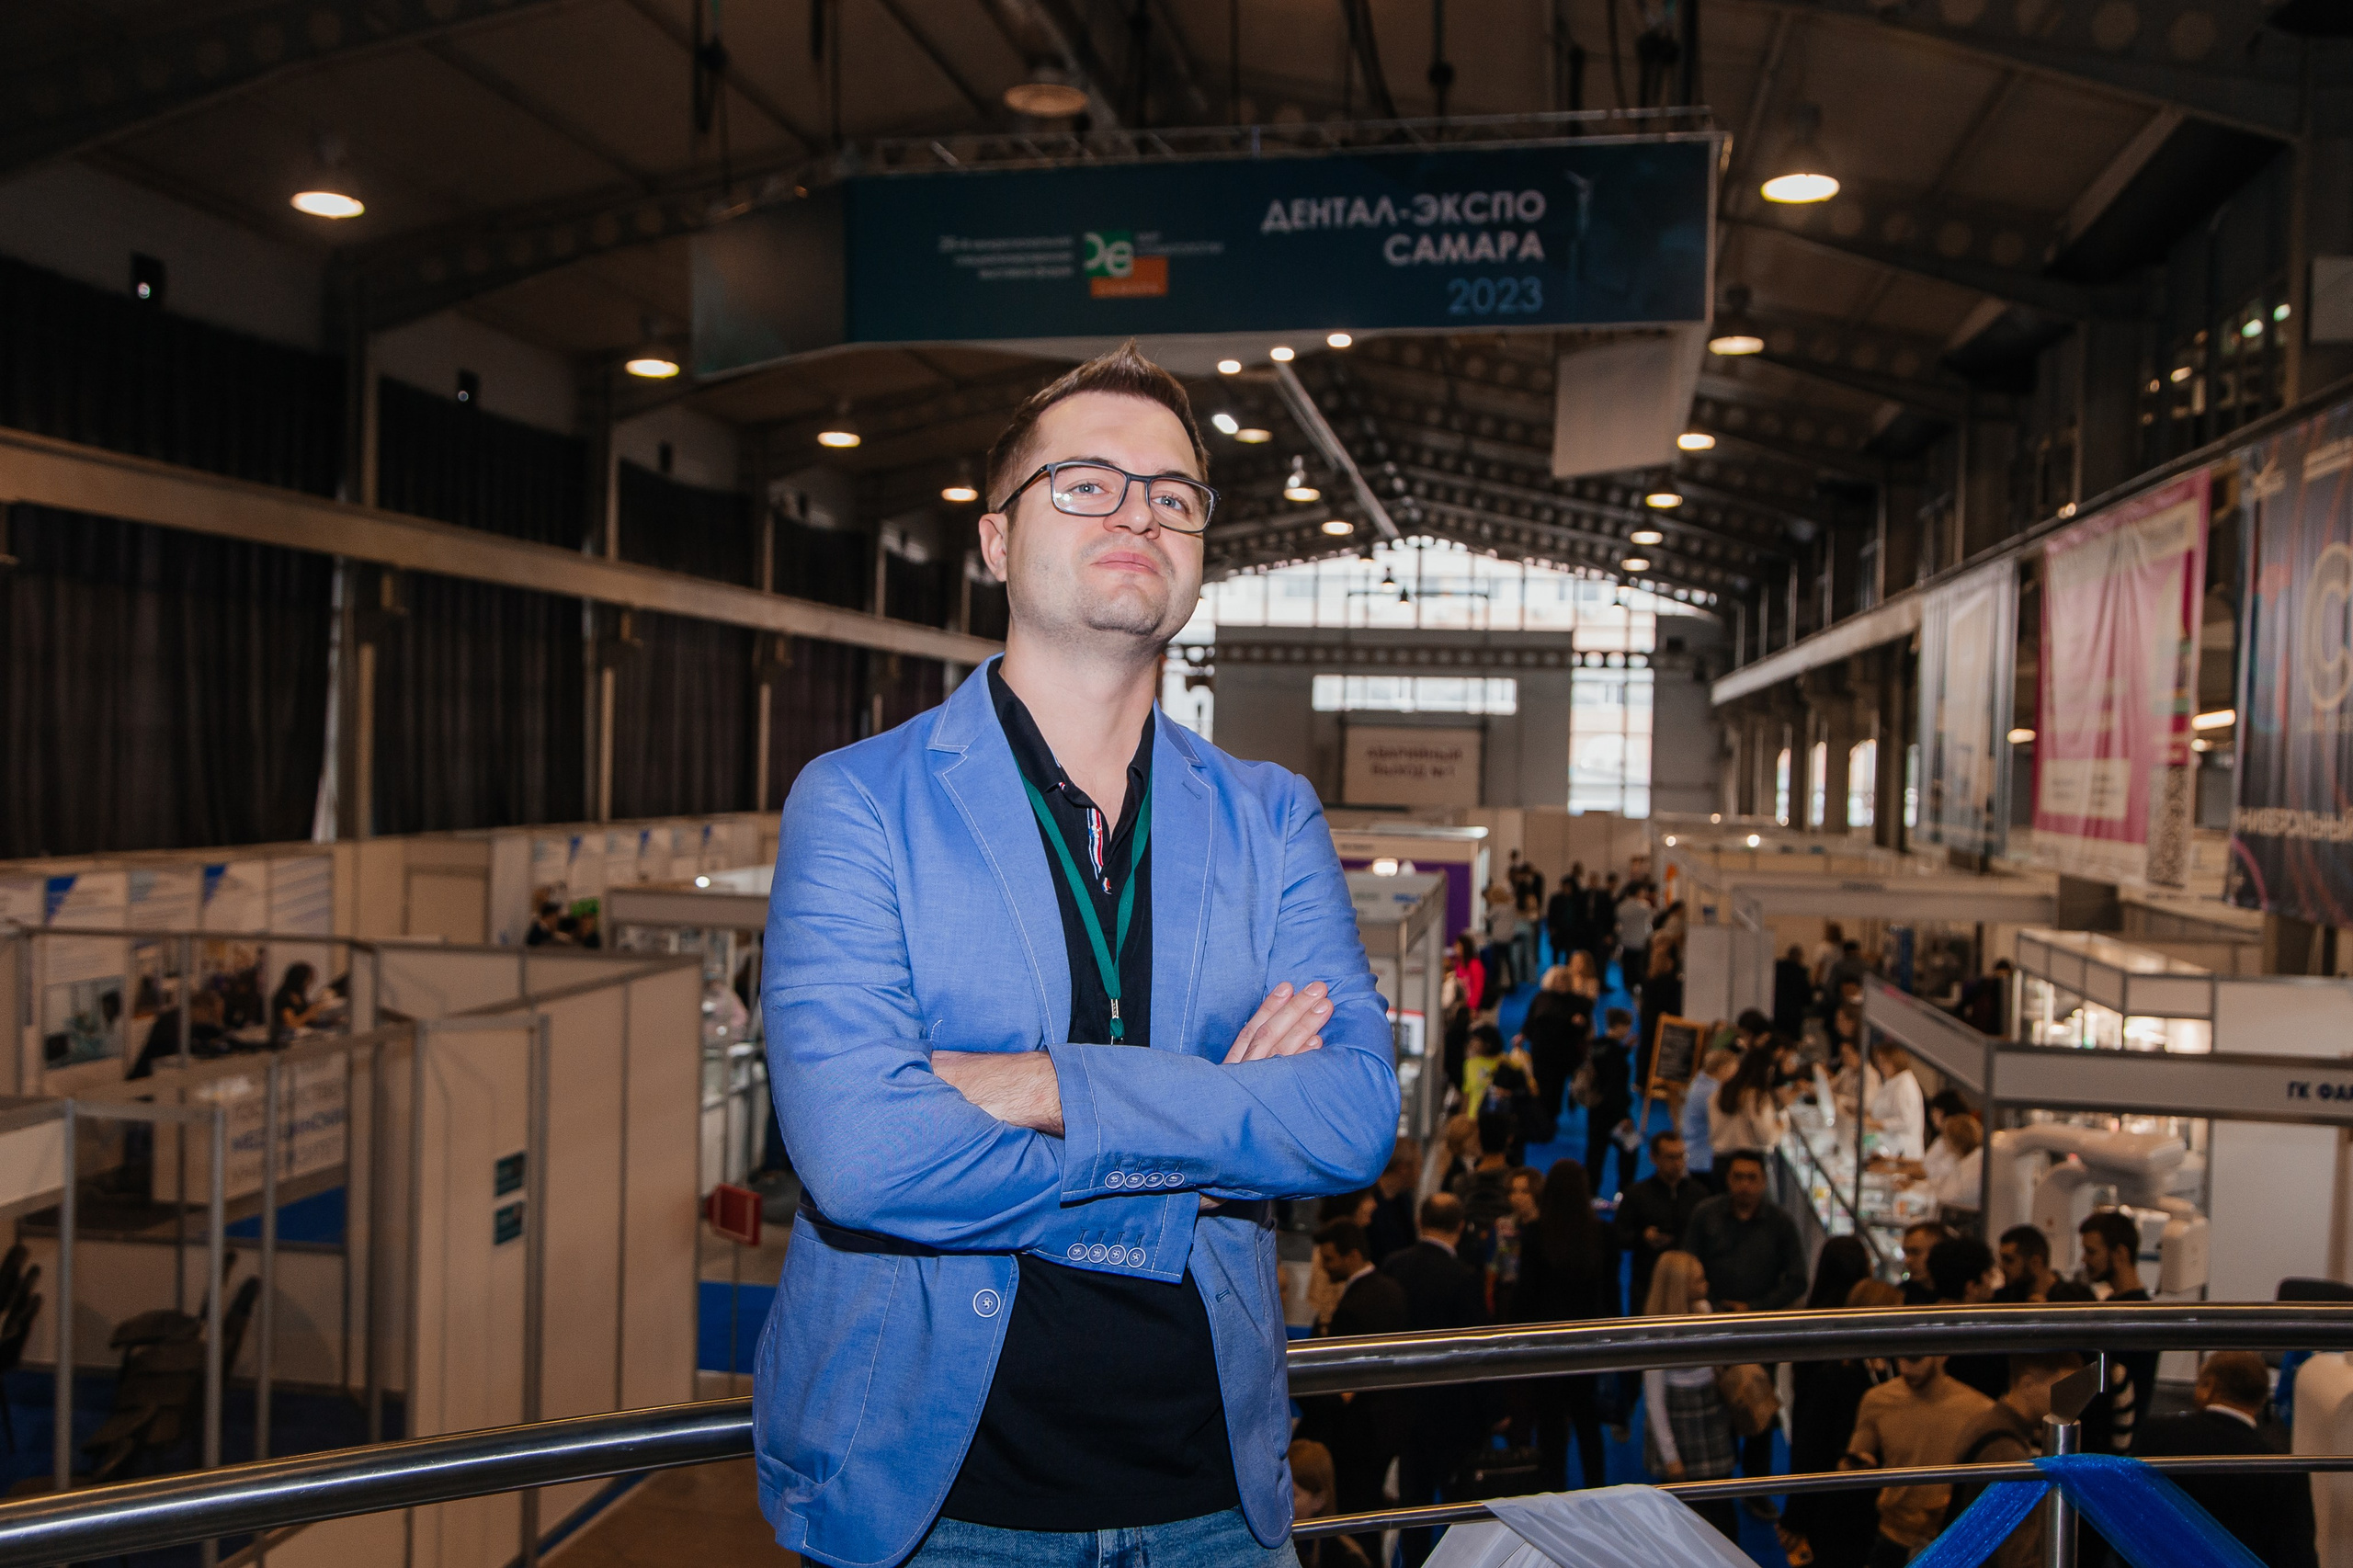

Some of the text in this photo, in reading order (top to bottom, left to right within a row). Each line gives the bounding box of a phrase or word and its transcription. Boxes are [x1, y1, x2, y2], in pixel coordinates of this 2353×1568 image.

[1261, 189, 1547, 234] ДЕНТАЛ-ЭКСПО
[1383, 231, 1545, 267] САМАРА
[1447, 276, 1544, 315] 2023
[2287, 1080, 2311, 1098] ГК
